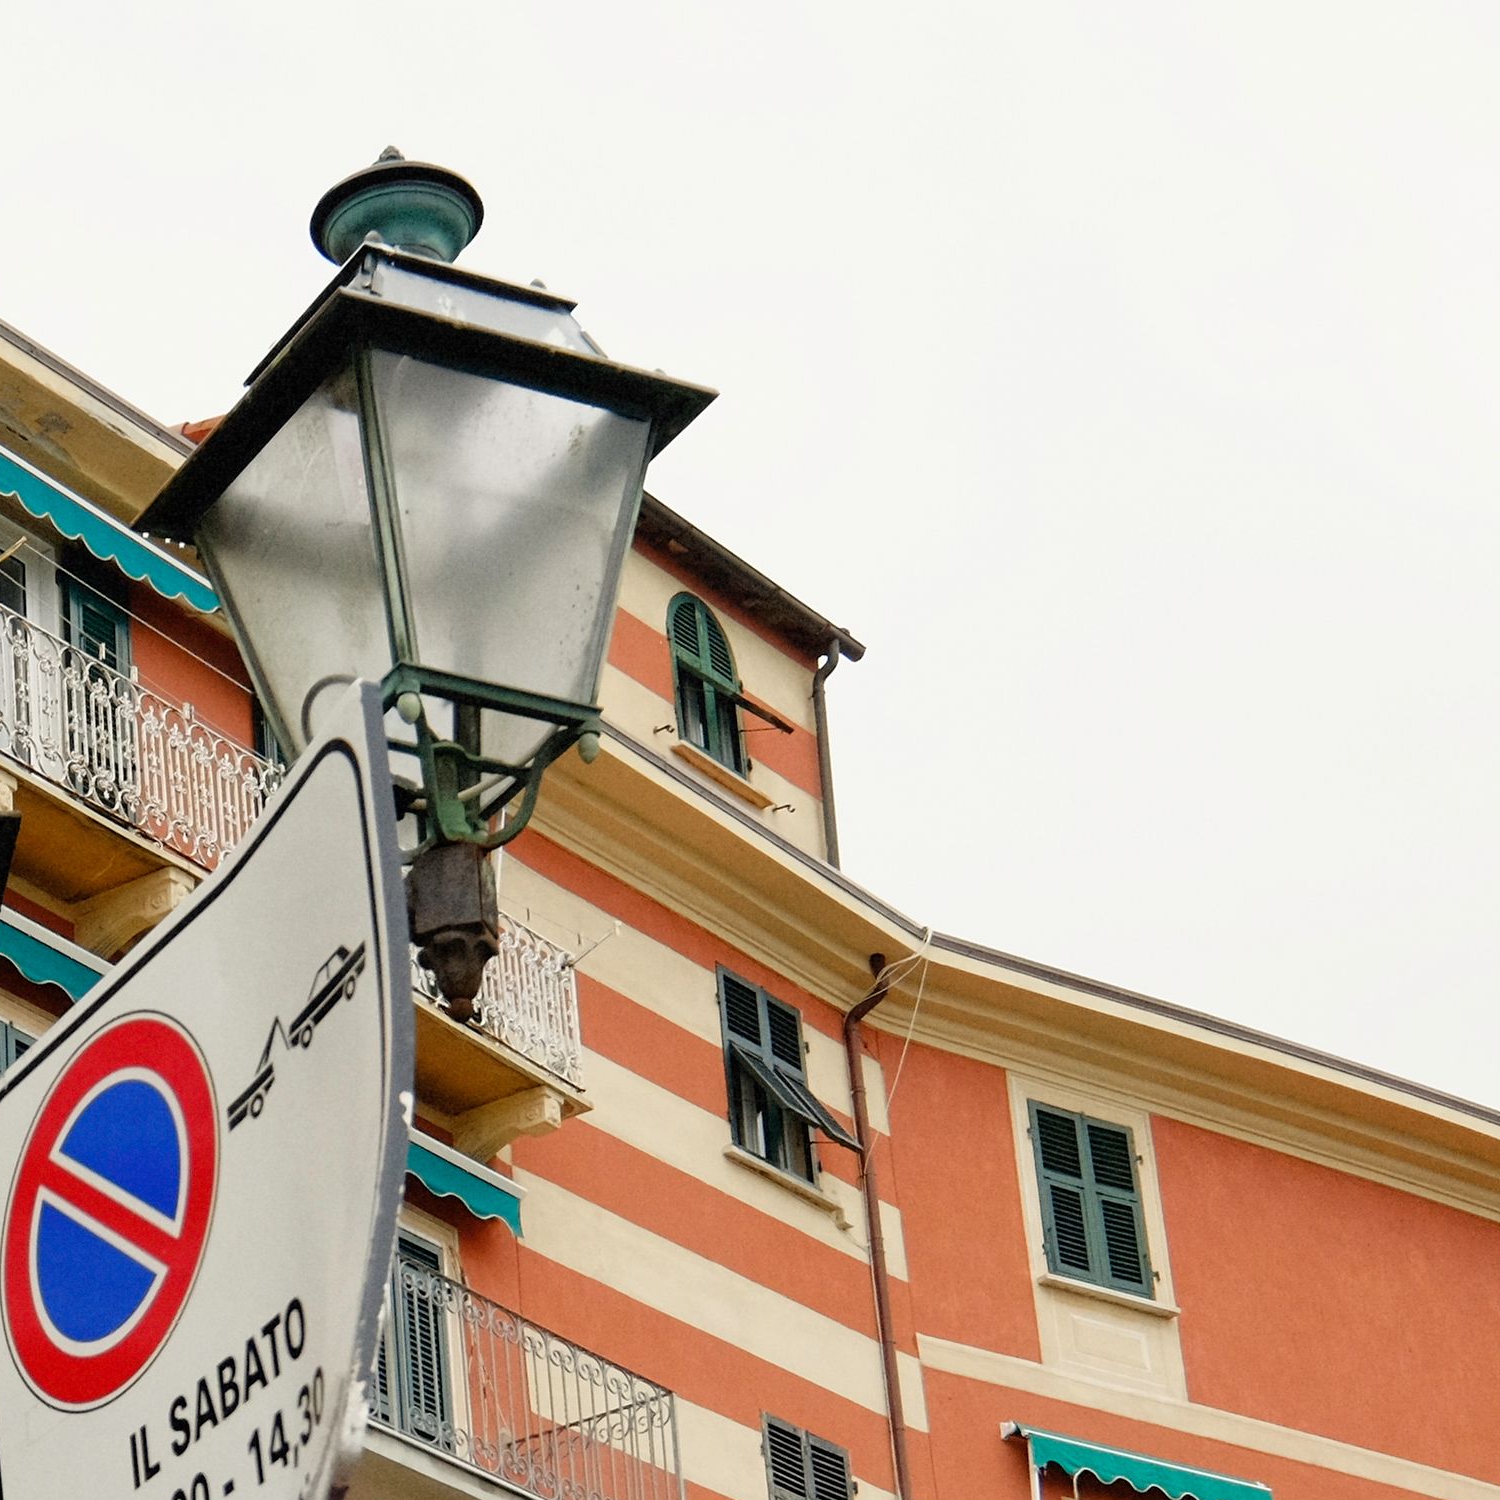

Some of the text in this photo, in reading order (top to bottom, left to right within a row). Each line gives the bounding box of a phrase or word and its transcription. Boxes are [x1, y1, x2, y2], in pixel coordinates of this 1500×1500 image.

[129, 1297, 306, 1490] IL SABATO
[223, 1479, 235, 1497] -
[248, 1365, 325, 1486] 14,30
